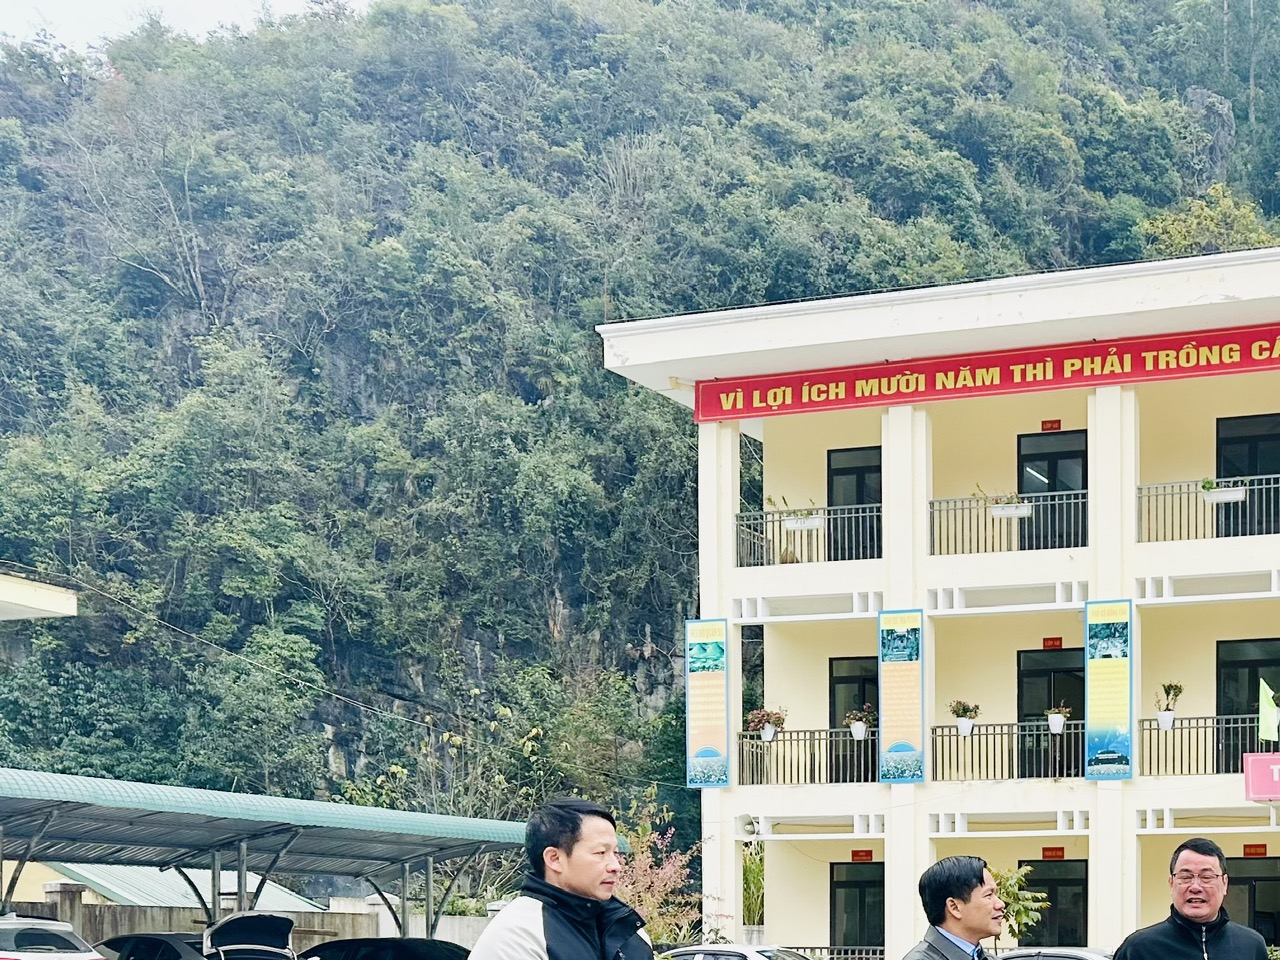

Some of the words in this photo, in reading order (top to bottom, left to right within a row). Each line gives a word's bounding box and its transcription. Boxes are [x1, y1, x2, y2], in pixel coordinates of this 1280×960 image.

[720, 388, 744, 410] VÌ
[753, 386, 792, 410] LỢI
[802, 381, 846, 403] ÍCH
[856, 373, 926, 398] MƯỜI
[936, 366, 1000, 391] NĂM
[1010, 357, 1054, 384] THÌ
[1064, 349, 1132, 379] PHẢI
[1142, 342, 1240, 372] TRỒNG
